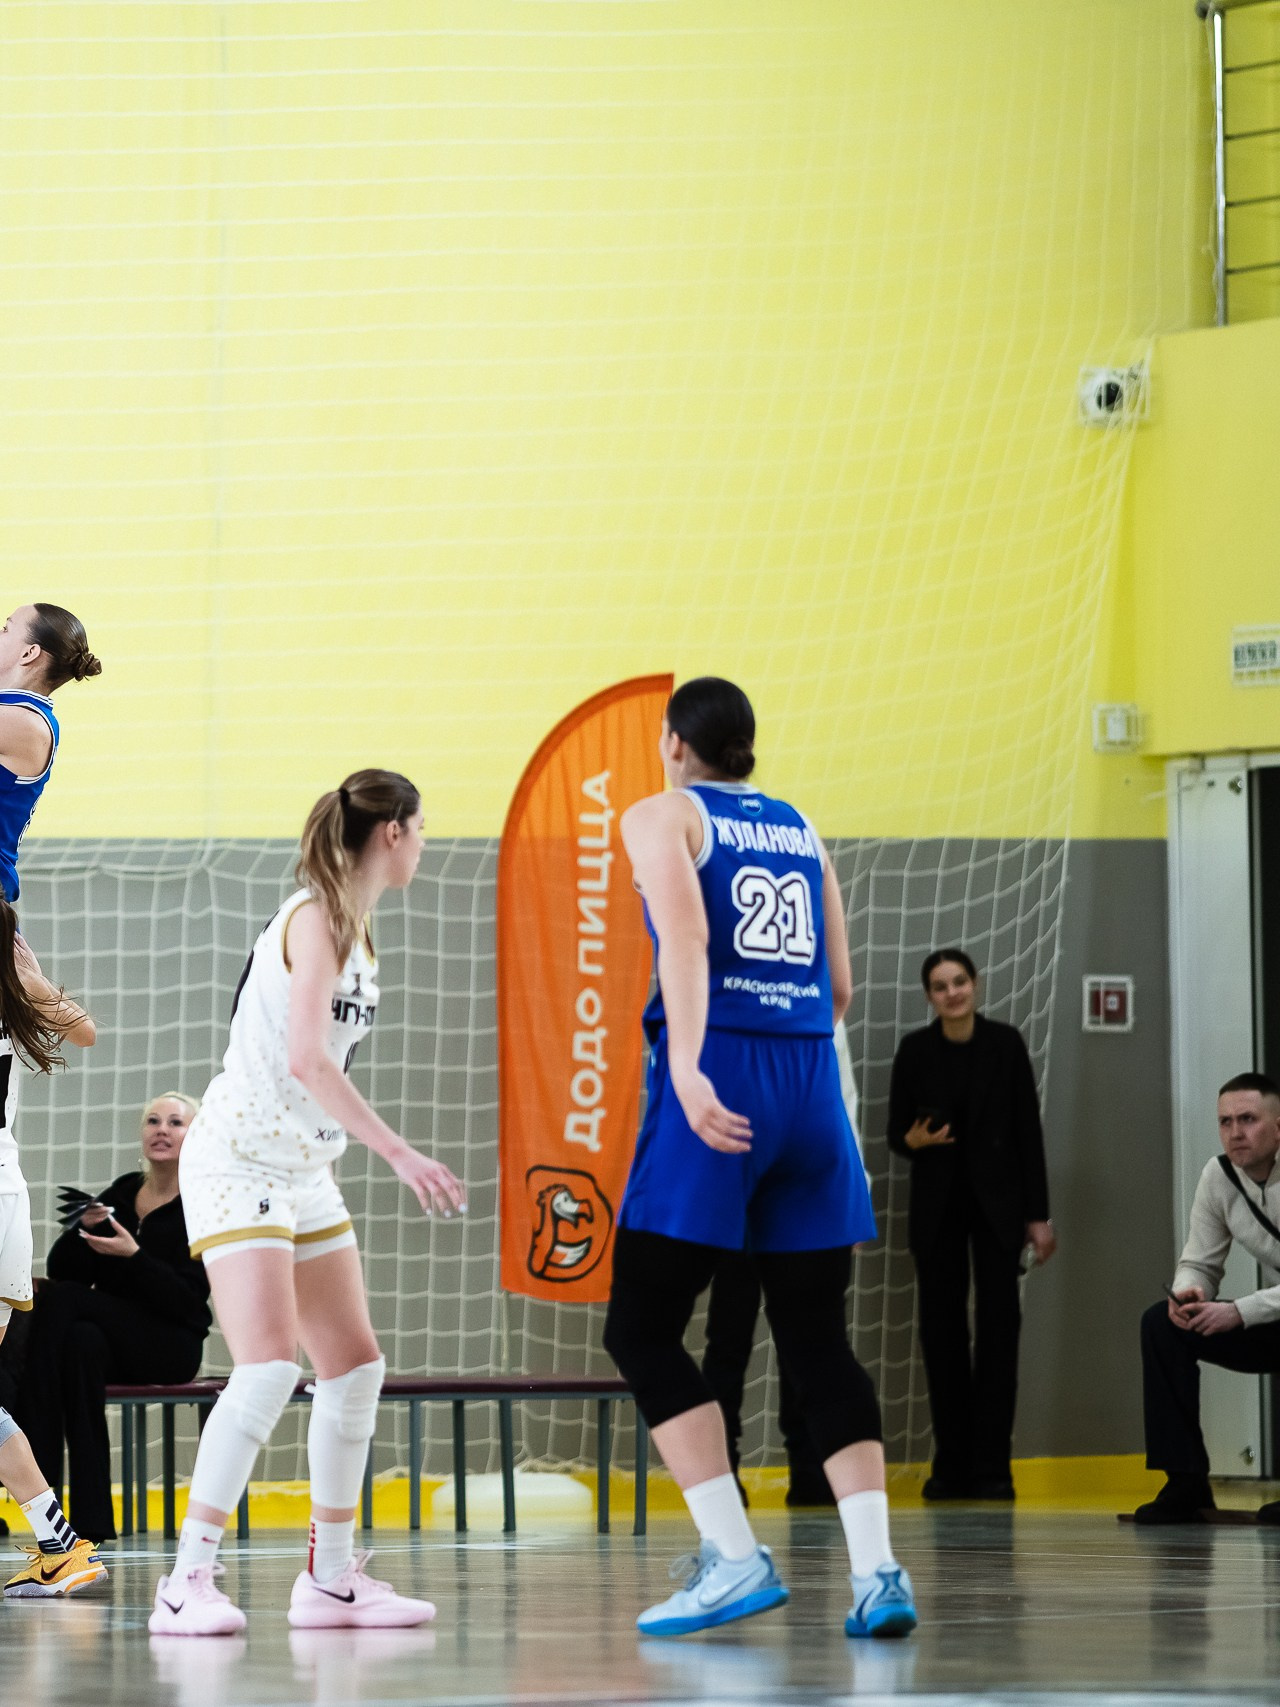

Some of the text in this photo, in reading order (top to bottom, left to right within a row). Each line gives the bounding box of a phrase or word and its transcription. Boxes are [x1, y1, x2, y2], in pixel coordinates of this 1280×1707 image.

[710, 814, 817, 860] ЖУЛАНОВА
[564, 769, 615, 1153] ДОДО ПИЦЦА
[731, 865, 816, 968] 21
